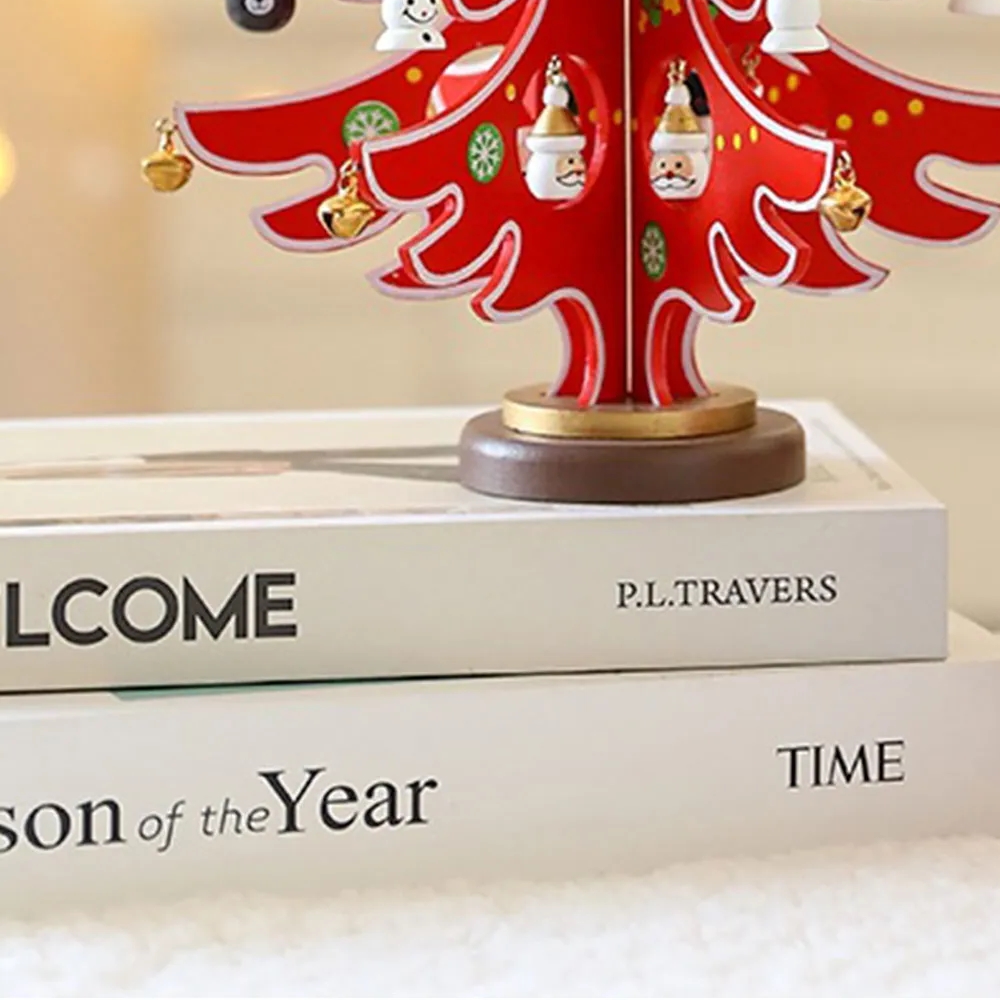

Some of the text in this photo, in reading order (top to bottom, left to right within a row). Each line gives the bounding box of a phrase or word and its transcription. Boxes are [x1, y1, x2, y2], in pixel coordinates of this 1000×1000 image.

[5, 572, 298, 649] LCOME
[776, 738, 906, 789] TIME
[138, 799, 186, 853] of
[200, 797, 270, 837] the
[258, 766, 438, 835] Year
